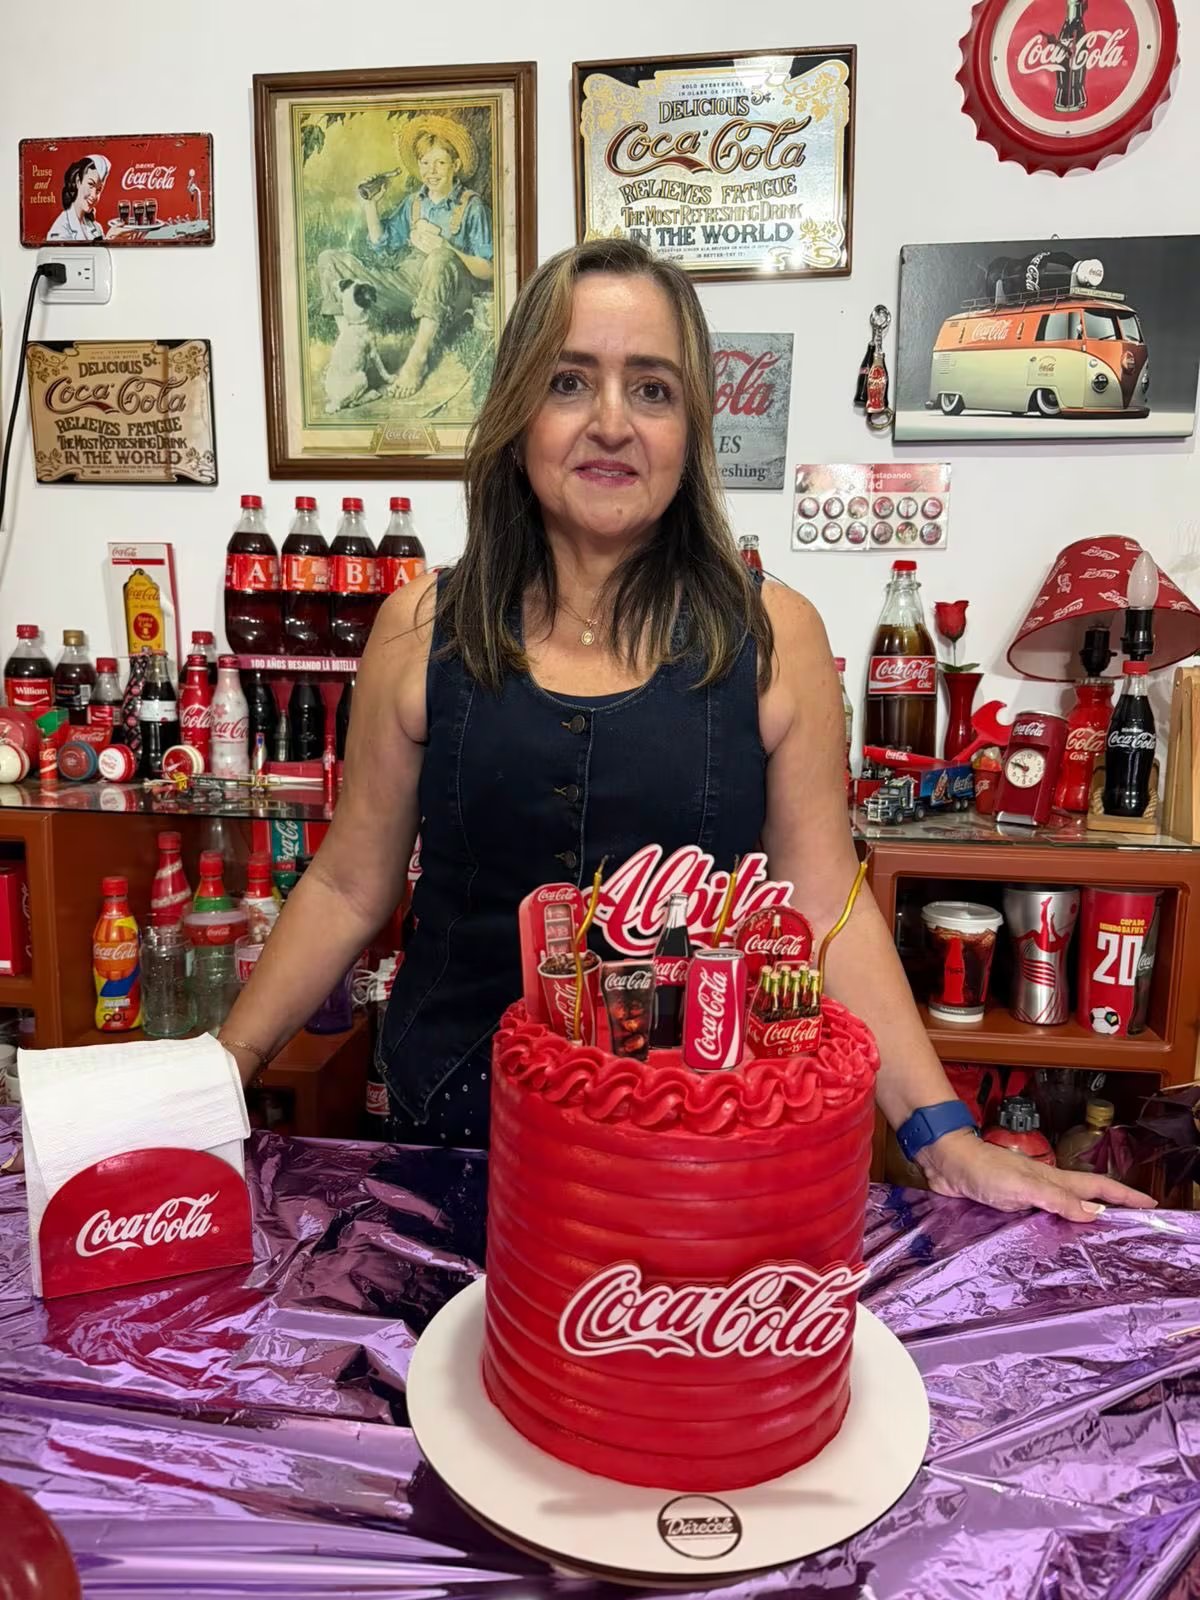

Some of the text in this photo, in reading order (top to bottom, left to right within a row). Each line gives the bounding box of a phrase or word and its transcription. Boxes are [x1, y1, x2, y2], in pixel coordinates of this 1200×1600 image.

[658, 95, 750, 124] DELICIOUS
[32, 165, 52, 177] Pause
[122, 166, 177, 190] Coca-Cola
[34, 178, 51, 189] and
[618, 174, 798, 206] RELIEVES FATIGUE
[30, 192, 56, 204] refresh
[645, 205, 678, 227] MOST
[680, 204, 759, 226] REFRESHING
[760, 201, 803, 222] DRINK
[630, 222, 794, 247] IN THE WORLD
[78, 360, 144, 378] DELICIOUS
[54, 416, 182, 437] RELIEVES FATIGUE
[156, 434, 188, 449] DRINK
[718, 435, 742, 454] ES
[64, 450, 182, 465] IN THE WORLD
[722, 464, 767, 481] eshing
[248, 561, 410, 586] A L B A
[250, 659, 265, 669] 100
[266, 657, 287, 670] AÑOS
[876, 659, 932, 681] Coca-Cola
[15, 686, 48, 696] William
[1108, 730, 1156, 750] Coca-Cola
[537, 888, 577, 902] Coca-Cola
[581, 844, 794, 957] Albita
[744, 933, 806, 956] Coca-Cola
[604, 970, 652, 991] Coca-Cola
[694, 968, 729, 1061] Coca-Cola
[763, 1015, 824, 1047] Coca-Cola
[76, 1190, 220, 1258] Coca-Cola
[558, 1262, 872, 1358] Coca-Cola
